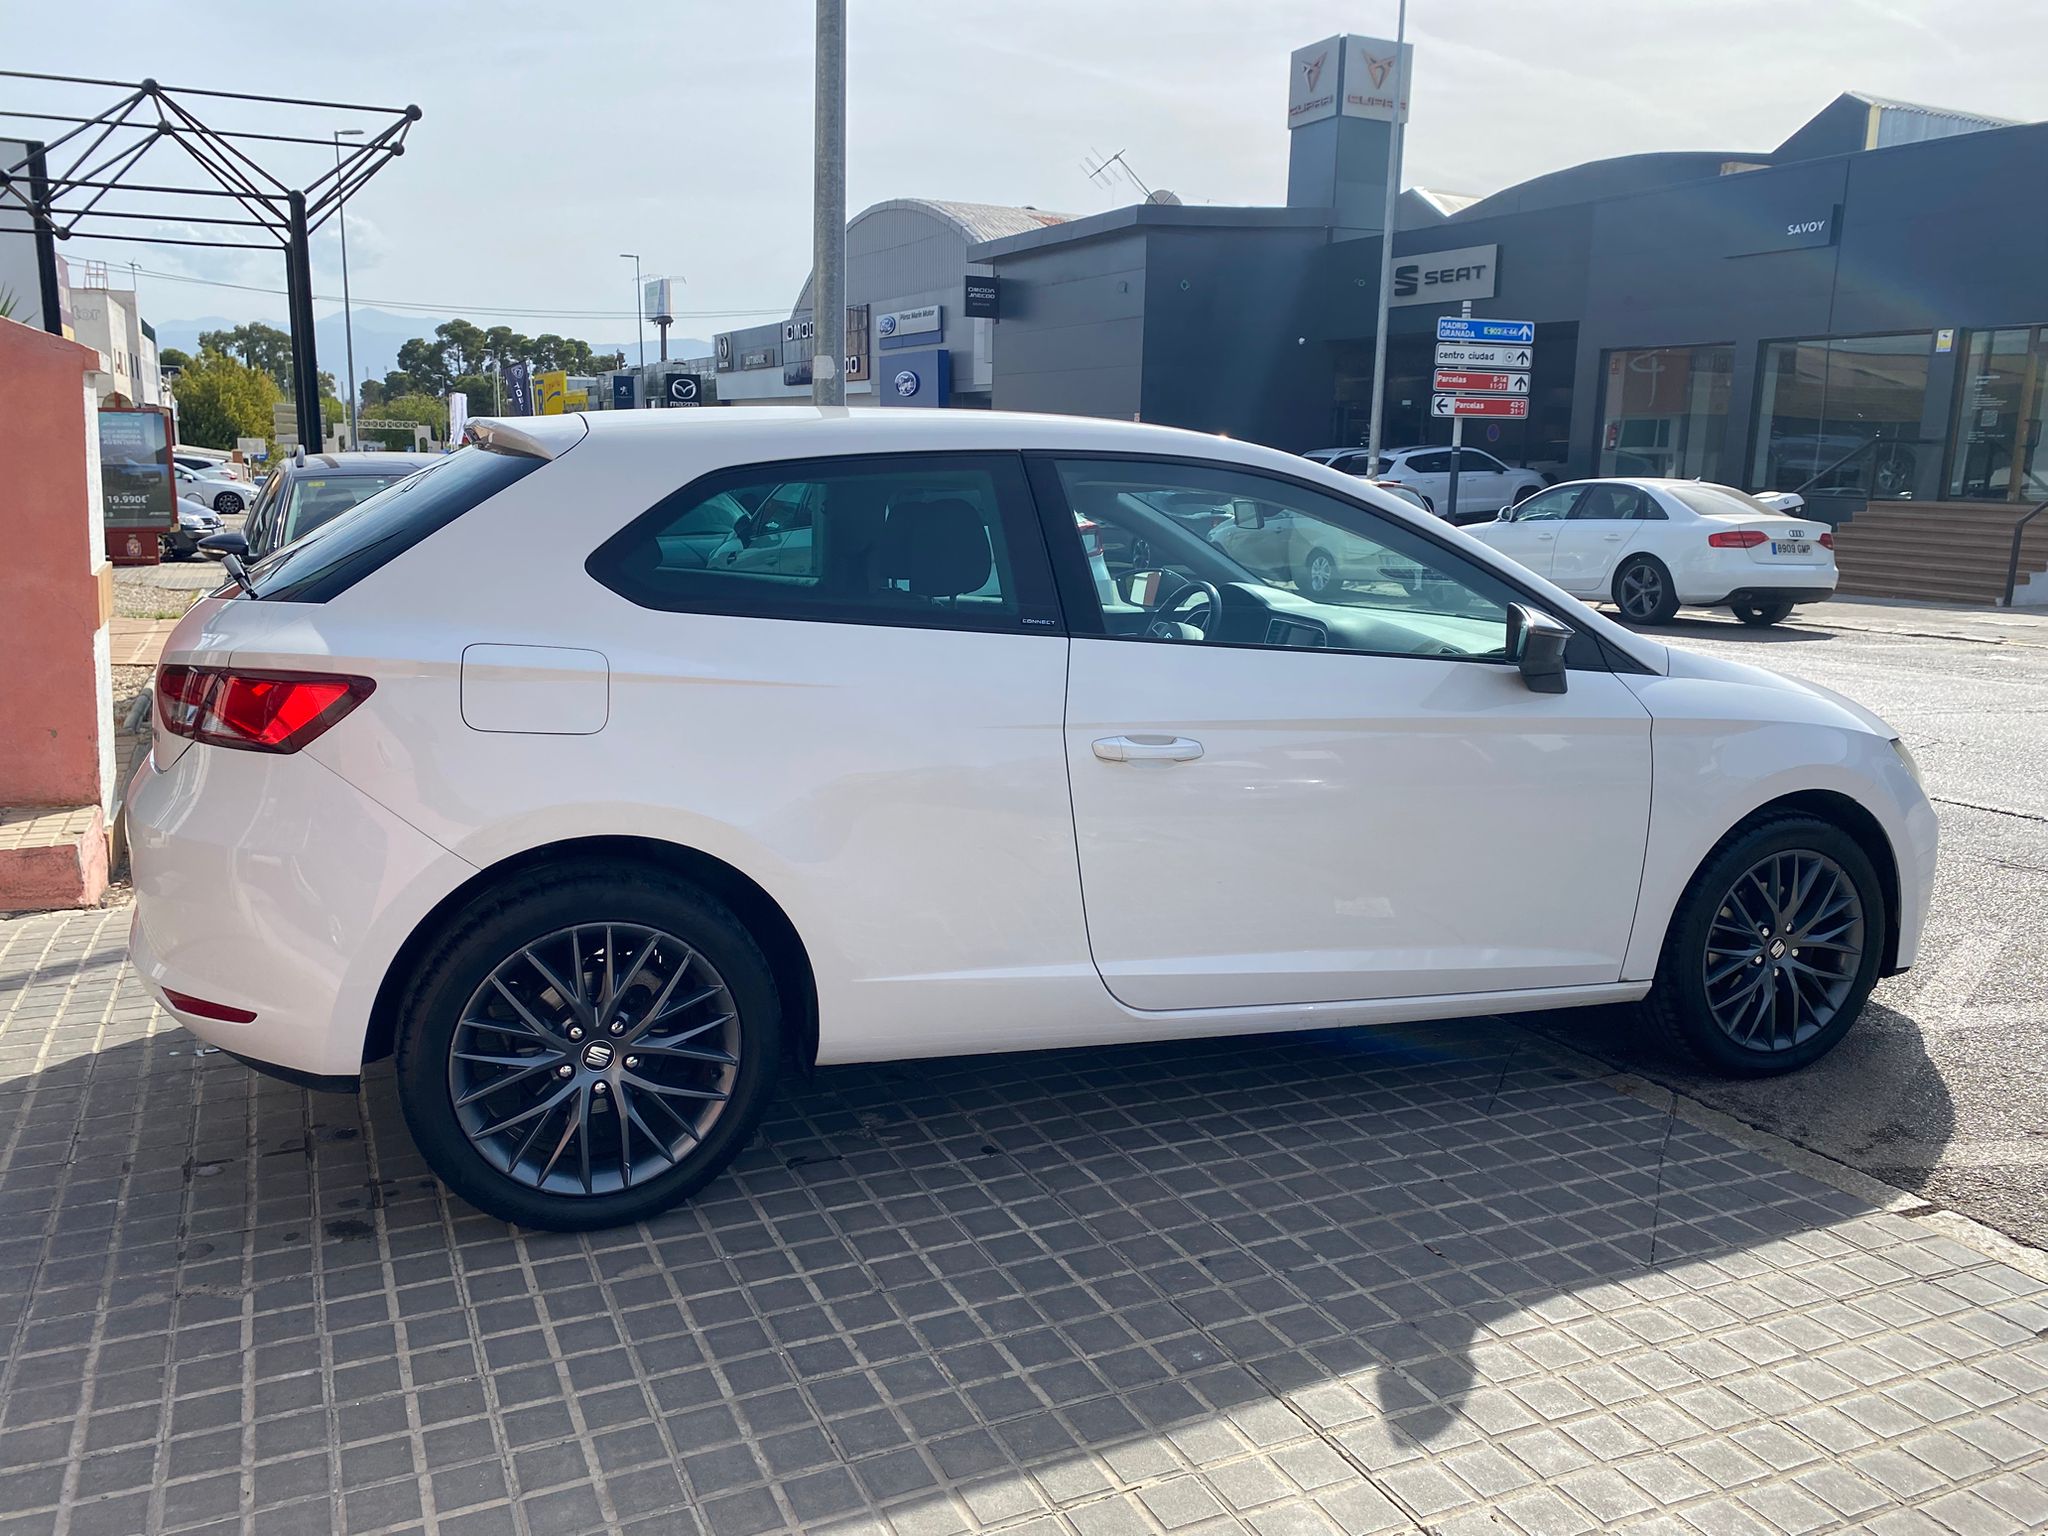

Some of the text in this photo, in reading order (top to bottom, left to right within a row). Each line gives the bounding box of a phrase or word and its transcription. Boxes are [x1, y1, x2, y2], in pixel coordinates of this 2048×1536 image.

[1289, 95, 1334, 116] CUPRA
[1787, 220, 1825, 235] SAVOY
[1424, 265, 1486, 285] SEAT
[1441, 321, 1468, 329] MADRID
[1441, 329, 1475, 338] GRANADA
[1439, 351, 1494, 360] centro ciudad
[1437, 374, 1467, 383] Parcelas
[1455, 401, 1485, 409] Parcelas
